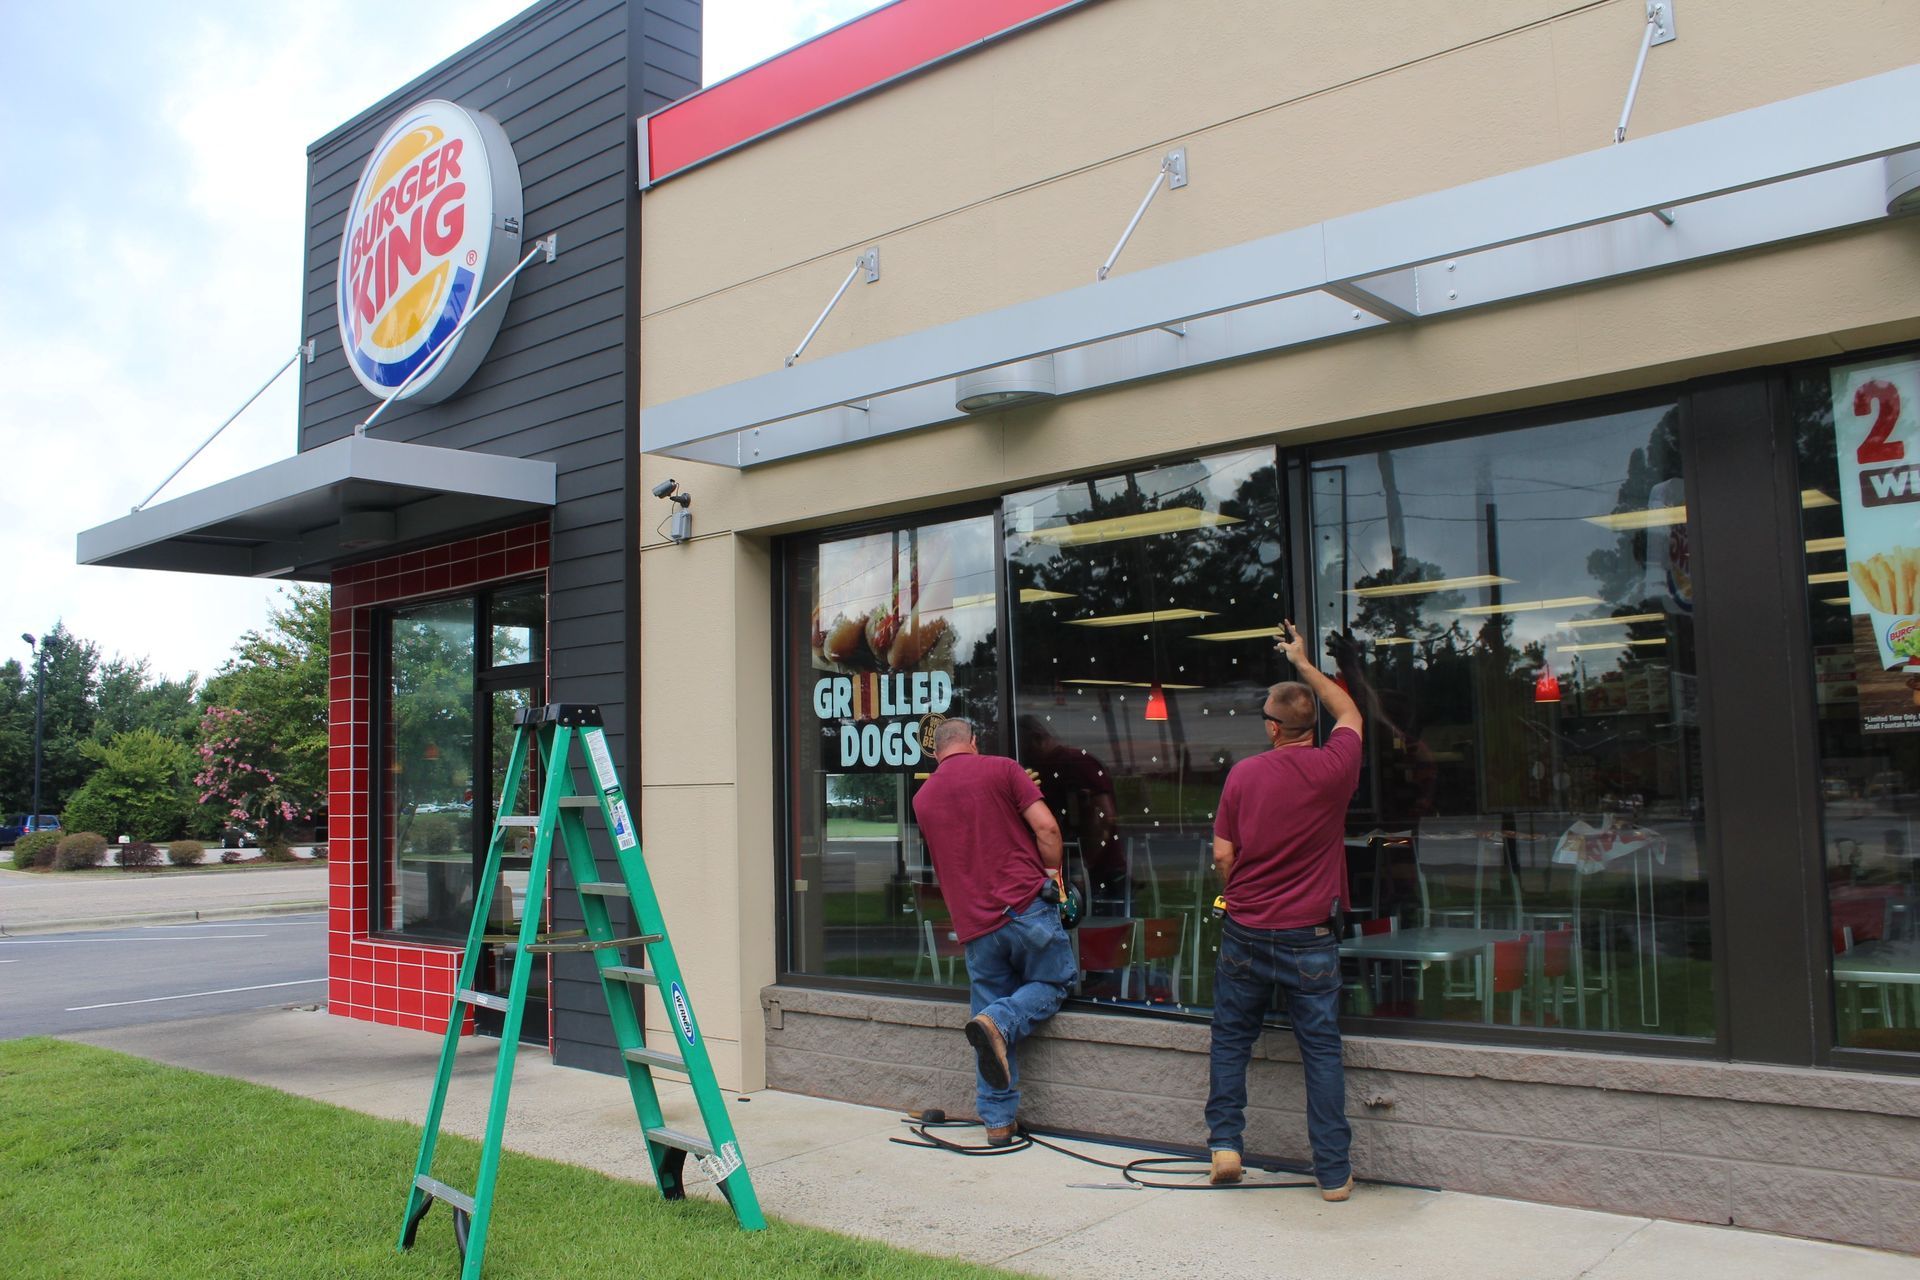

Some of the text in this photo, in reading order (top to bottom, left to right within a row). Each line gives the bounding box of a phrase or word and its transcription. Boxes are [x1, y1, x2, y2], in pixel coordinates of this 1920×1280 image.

[351, 138, 464, 281] BURGER
[351, 182, 466, 347] KING
[1854, 379, 1905, 465] 2
[813, 670, 952, 721] GRILLED
[840, 721, 921, 767] DOGS
[675, 995, 692, 1033] WERNER
